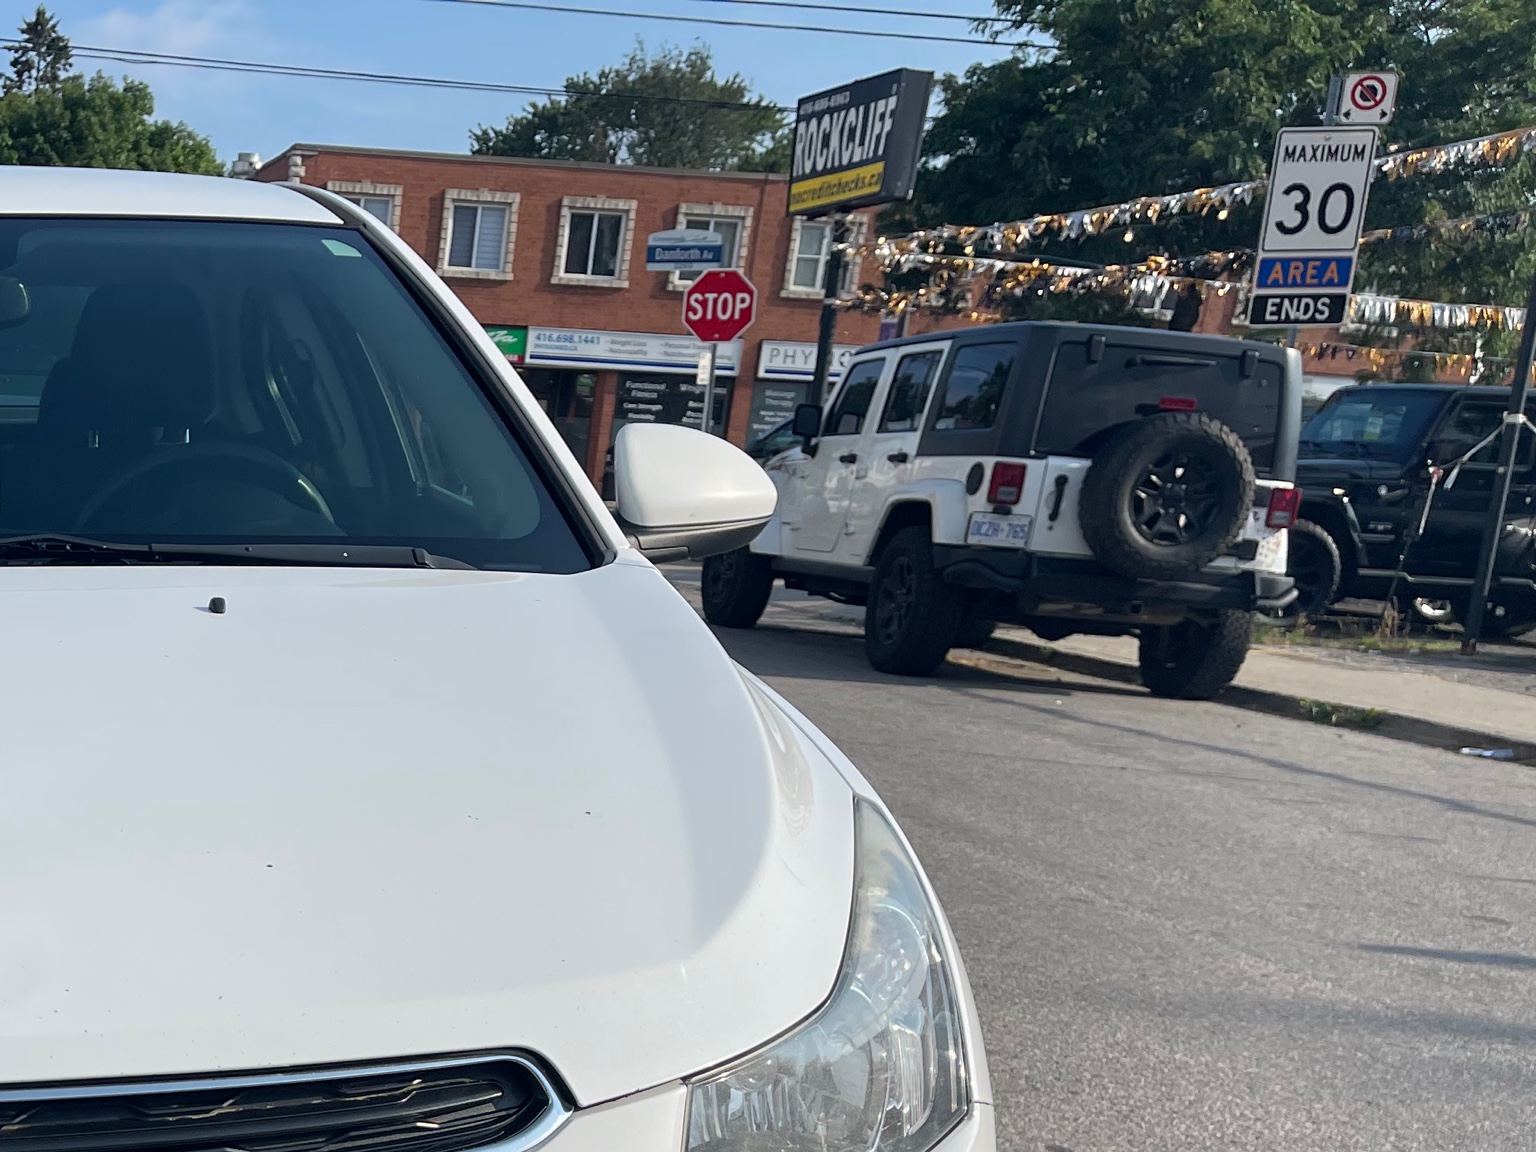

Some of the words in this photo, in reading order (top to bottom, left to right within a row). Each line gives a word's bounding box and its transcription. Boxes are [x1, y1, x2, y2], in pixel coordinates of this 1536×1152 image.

[792, 95, 898, 177] ROCKCLIFF
[1282, 143, 1367, 163] MAXIMUM
[1275, 182, 1355, 235] 30
[654, 247, 702, 260] Danforth
[1267, 261, 1339, 285] AREA
[687, 292, 751, 320] STOP
[1264, 297, 1331, 321] ENDS
[534, 332, 601, 345] 416.698.1441
